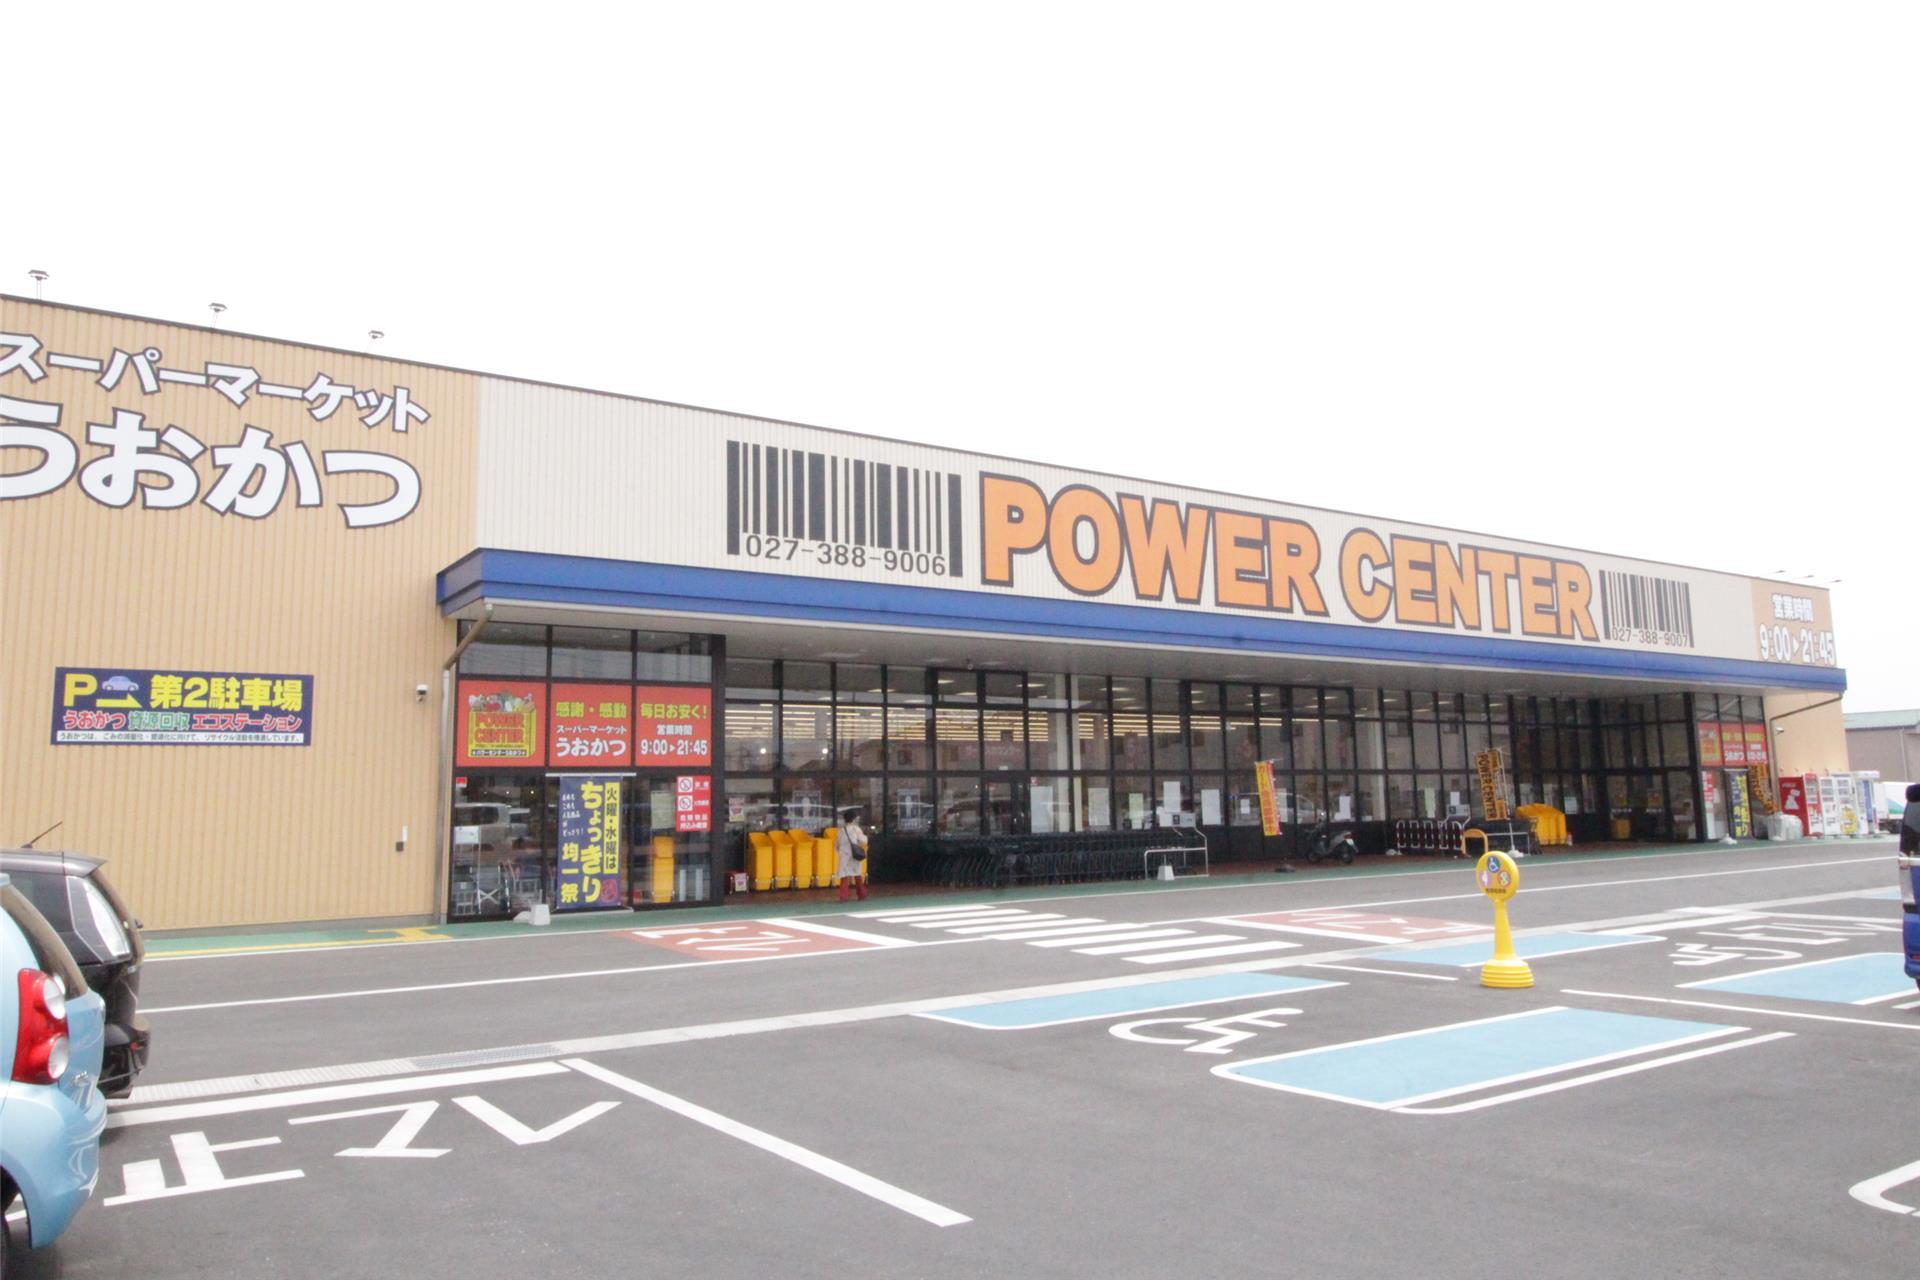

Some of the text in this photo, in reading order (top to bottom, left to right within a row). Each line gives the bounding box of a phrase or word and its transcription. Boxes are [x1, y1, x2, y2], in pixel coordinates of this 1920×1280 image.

[0, 333, 431, 433] スーパーマーケット
[0, 394, 422, 528] うおかつ
[746, 535, 946, 576] 027-388-9006
[979, 471, 1600, 642] POWER CENTER
[63, 674, 303, 712] P 第2駐車場
[556, 725, 627, 735] スーパーマーケット
[556, 737, 626, 757] うおかつ
[561, 842, 579, 903] 均一祭
[581, 781, 603, 903] ちょっきり
